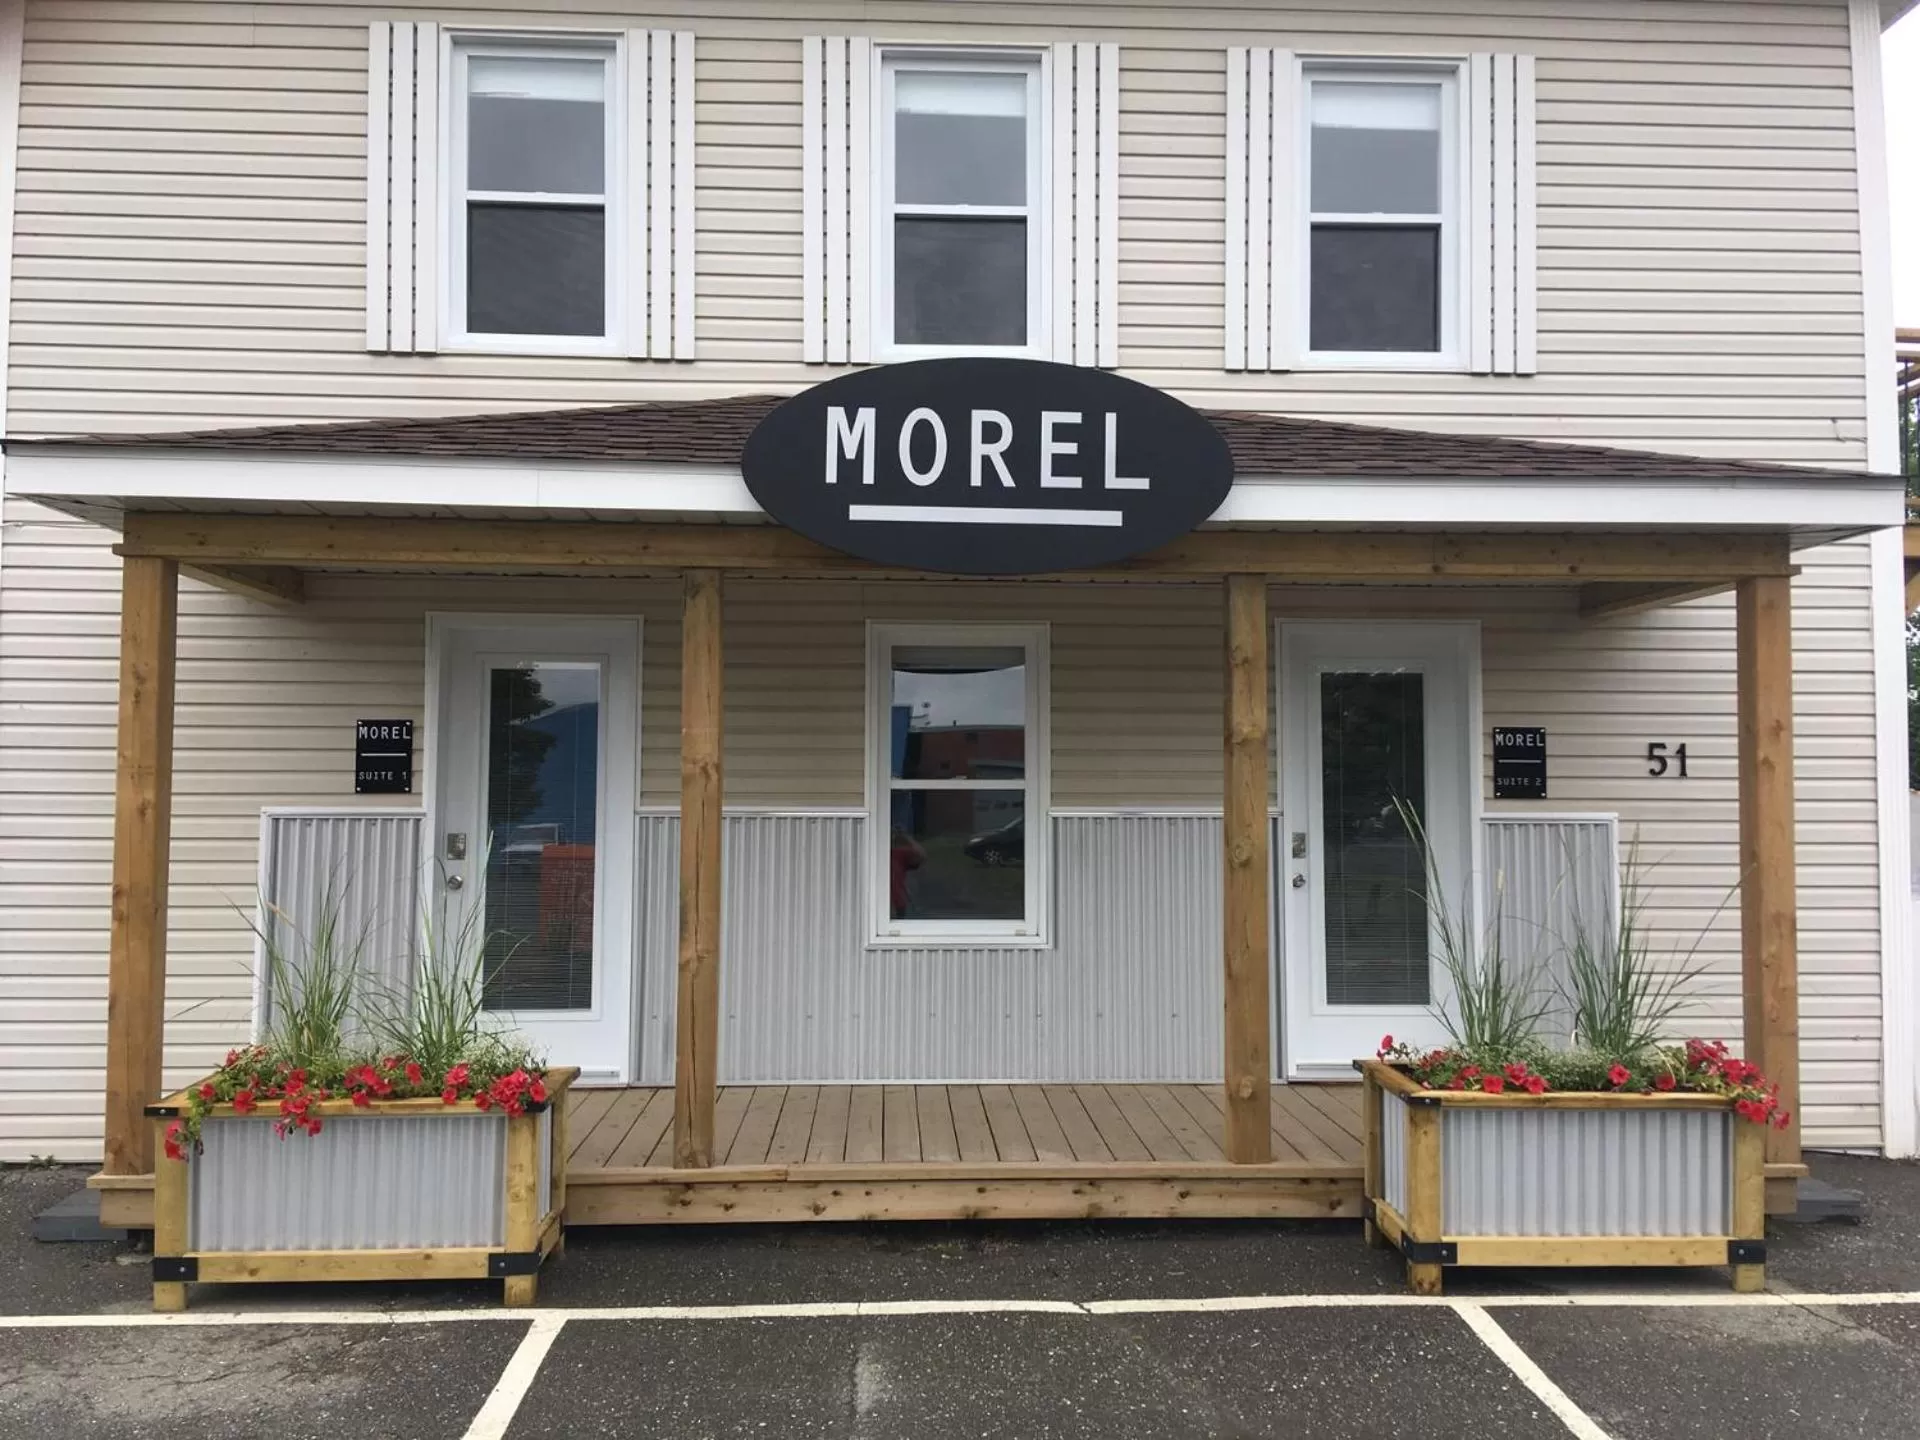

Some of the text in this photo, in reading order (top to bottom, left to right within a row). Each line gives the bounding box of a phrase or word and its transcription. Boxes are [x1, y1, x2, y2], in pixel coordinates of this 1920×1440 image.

[825, 405, 1151, 490] MOREL
[359, 726, 411, 740] MOREL
[1495, 734, 1544, 747] MOREL
[1648, 742, 1688, 778] 51
[359, 771, 407, 780] SUITE 1
[1497, 777, 1542, 786] SUITE 2
